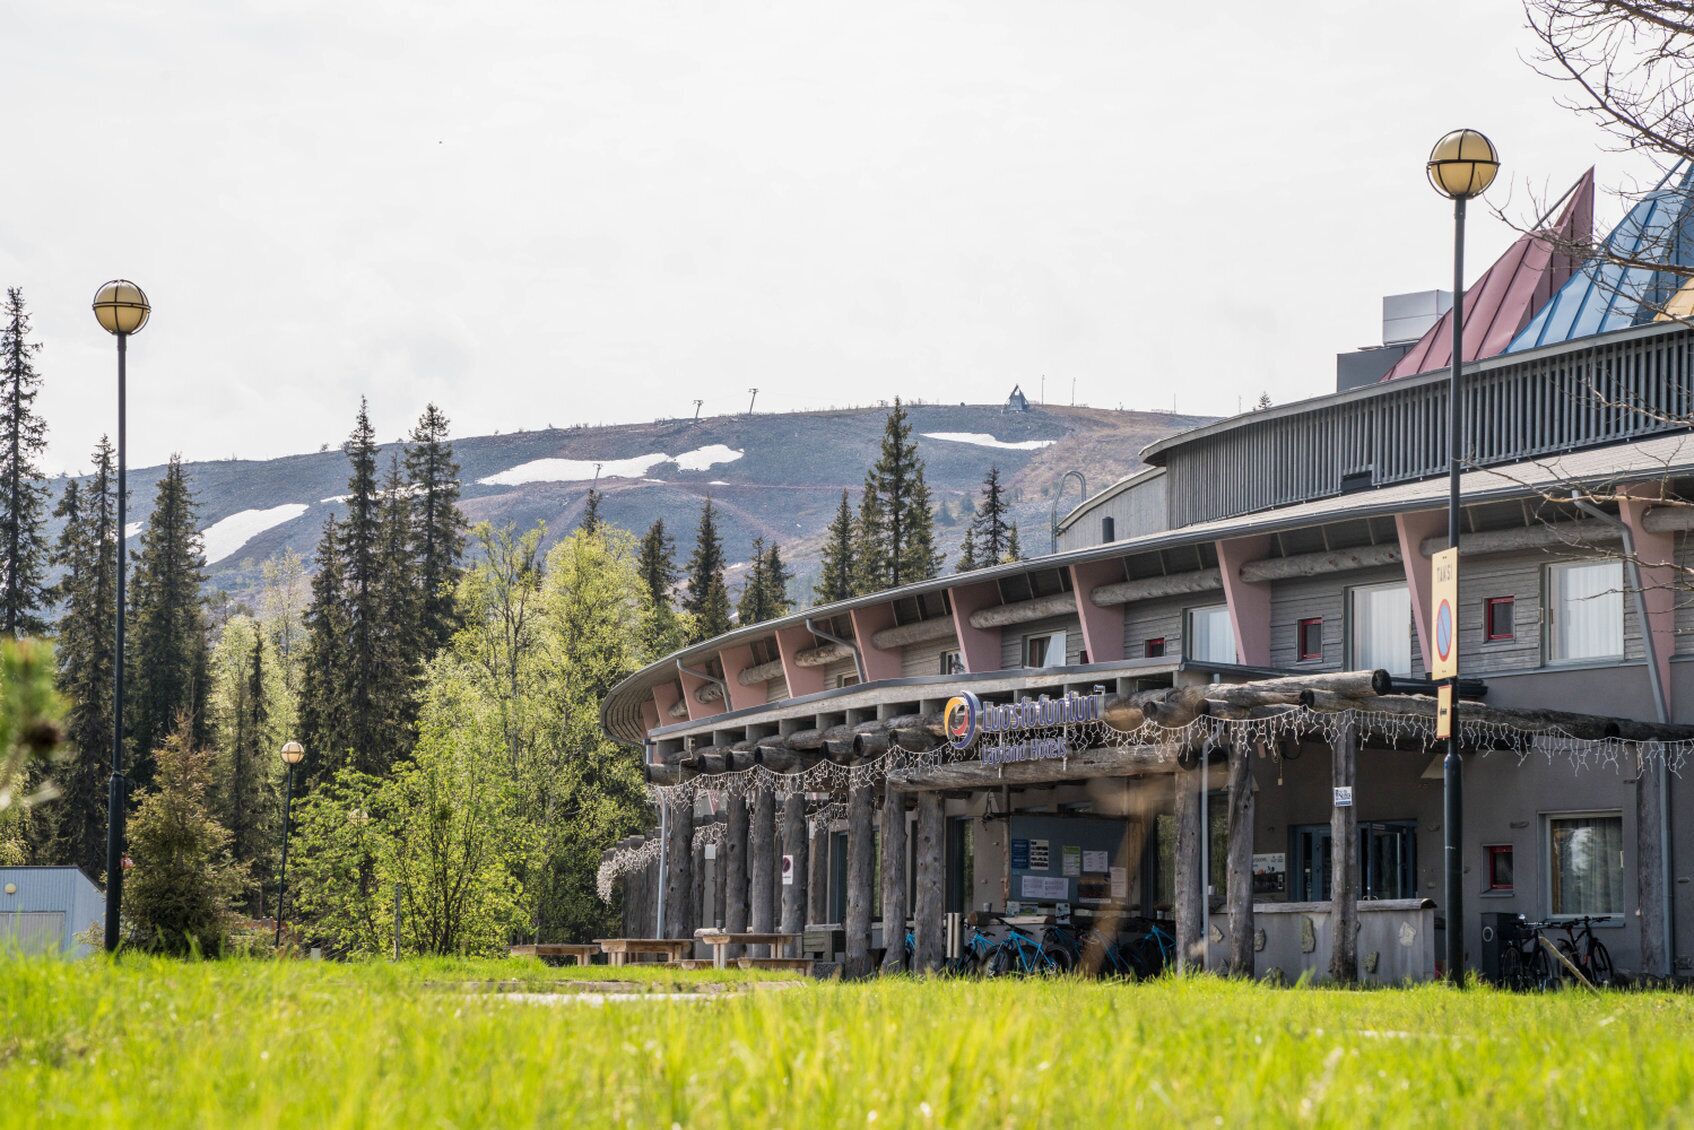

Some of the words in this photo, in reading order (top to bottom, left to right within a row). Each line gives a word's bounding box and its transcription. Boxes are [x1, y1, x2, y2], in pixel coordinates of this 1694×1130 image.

[1436, 563, 1453, 583] TAKSI
[982, 686, 1102, 732] Luostotunturi
[982, 739, 1027, 766] Lapland
[1030, 736, 1068, 761] Hotels
